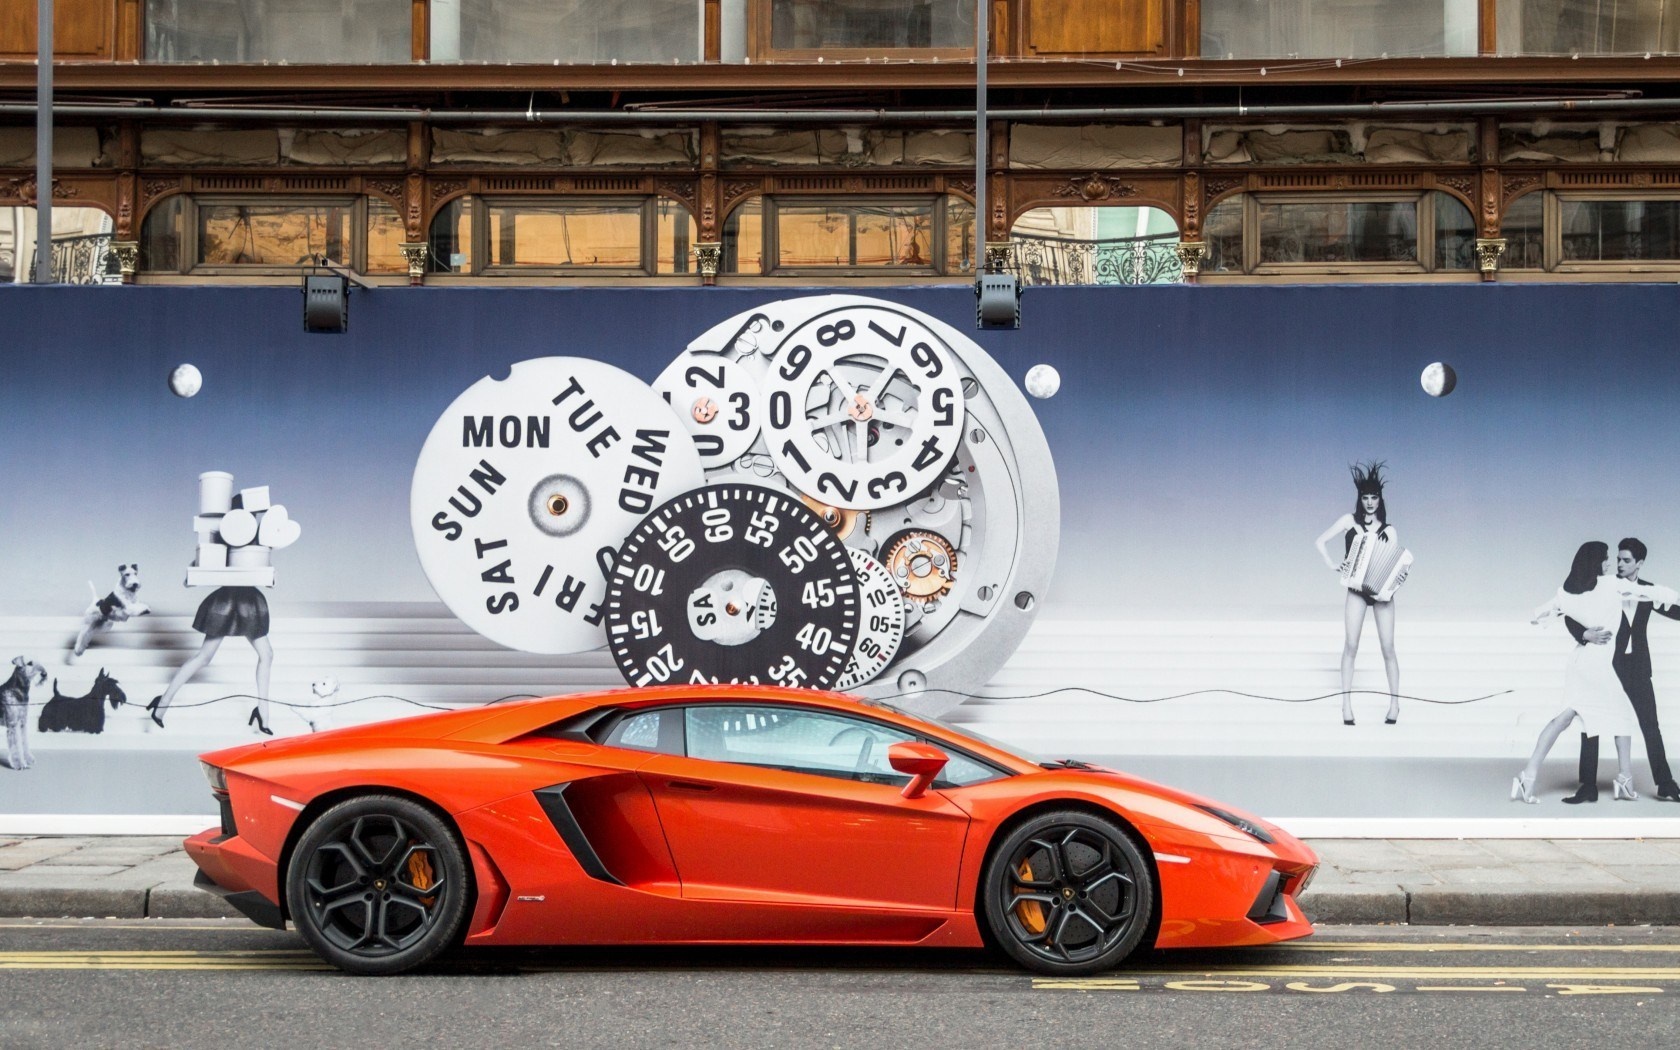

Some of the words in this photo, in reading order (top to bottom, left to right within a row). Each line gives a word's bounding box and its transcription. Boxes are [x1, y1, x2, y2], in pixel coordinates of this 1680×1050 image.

[816, 319, 856, 347] 8
[867, 319, 907, 347] 7
[685, 366, 725, 388] 2
[552, 376, 621, 459] TUE
[728, 391, 750, 431] 3
[769, 391, 792, 430] 0
[932, 387, 954, 426] 5
[462, 415, 550, 449] MON
[781, 439, 812, 474] 1
[911, 434, 944, 472] 4
[618, 428, 670, 515] WED
[817, 471, 858, 502] 2
[867, 470, 907, 499] 3
[431, 459, 507, 541] SUN
[701, 507, 734, 543] 60
[744, 510, 780, 548] 55
[778, 536, 819, 574] 50
[475, 537, 520, 615] SAT
[633, 563, 666, 597] 10
[801, 578, 835, 609] 45
[866, 589, 886, 608] 10
[631, 609, 663, 640] 15
[795, 622, 833, 656] 40
[870, 615, 890, 633] 05
[645, 643, 685, 683] 20
[858, 637, 881, 659] 60
